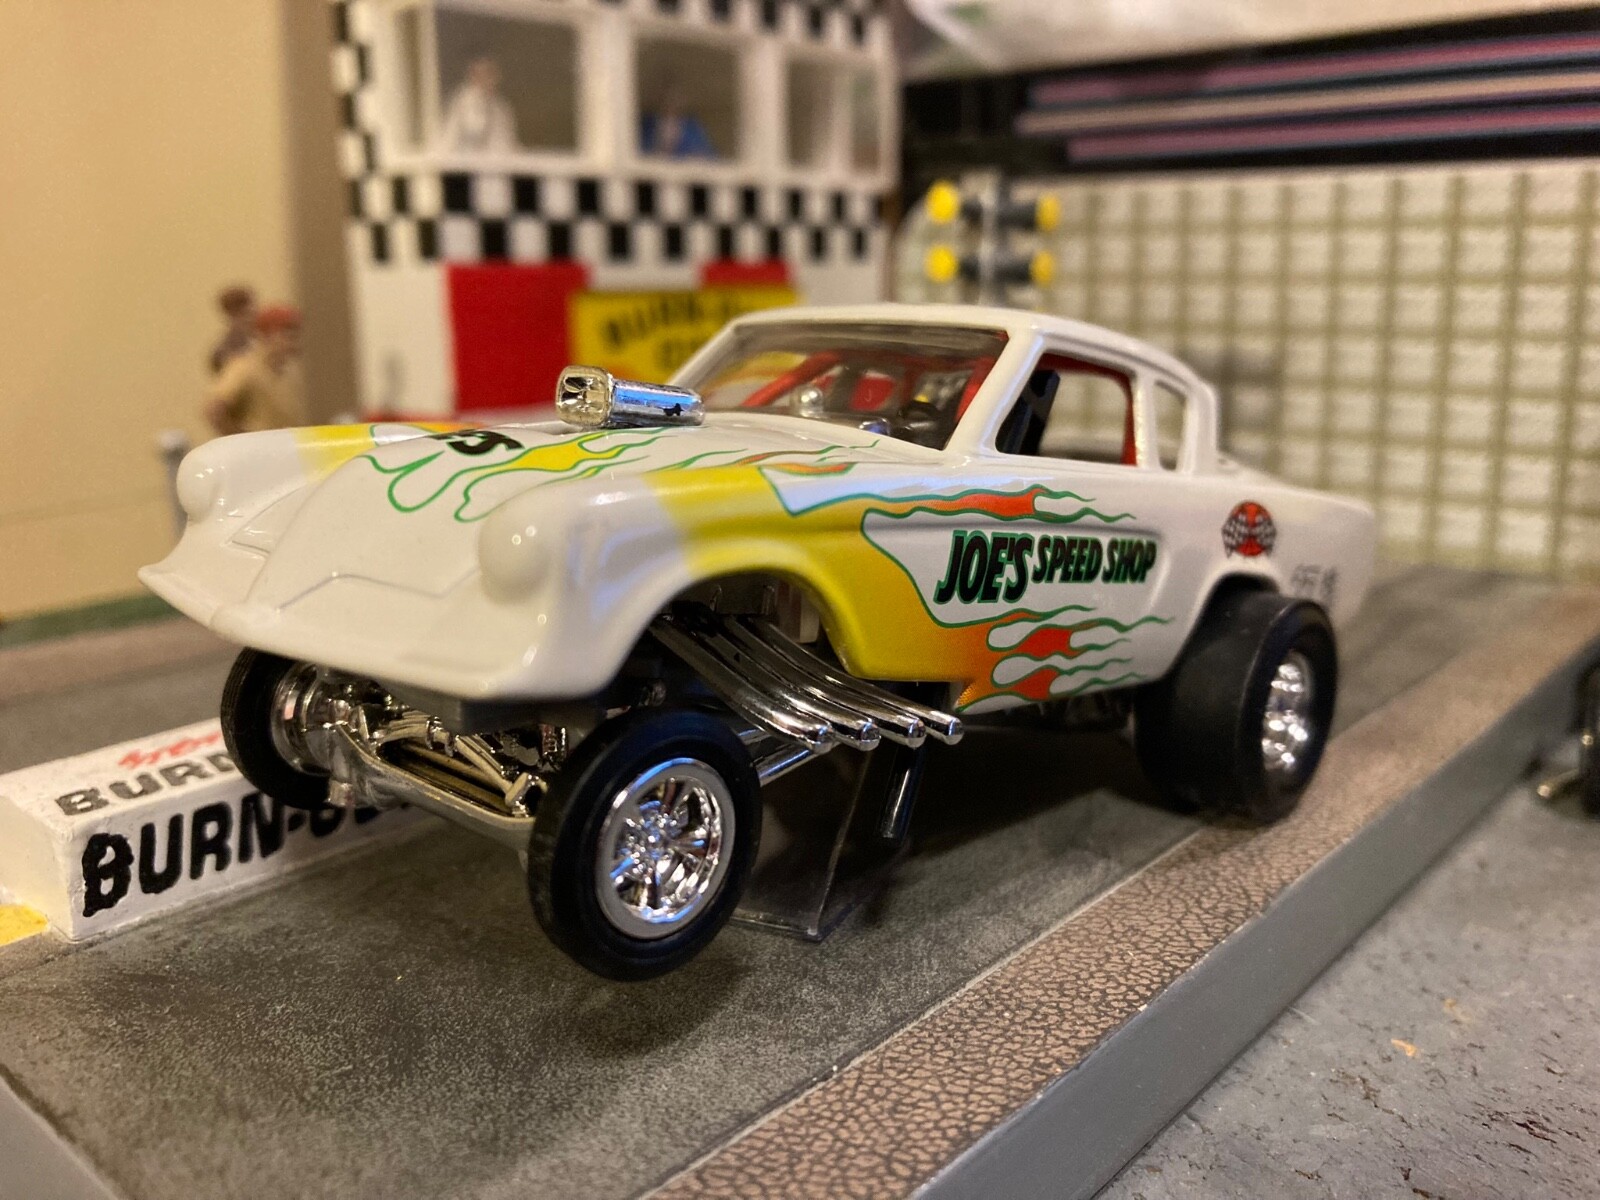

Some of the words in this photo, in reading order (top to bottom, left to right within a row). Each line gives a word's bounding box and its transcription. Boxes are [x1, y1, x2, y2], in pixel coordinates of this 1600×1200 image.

[933, 530, 1035, 605] JOE'S
[1031, 534, 1104, 584] SPEED
[1101, 536, 1158, 584] SHOP
